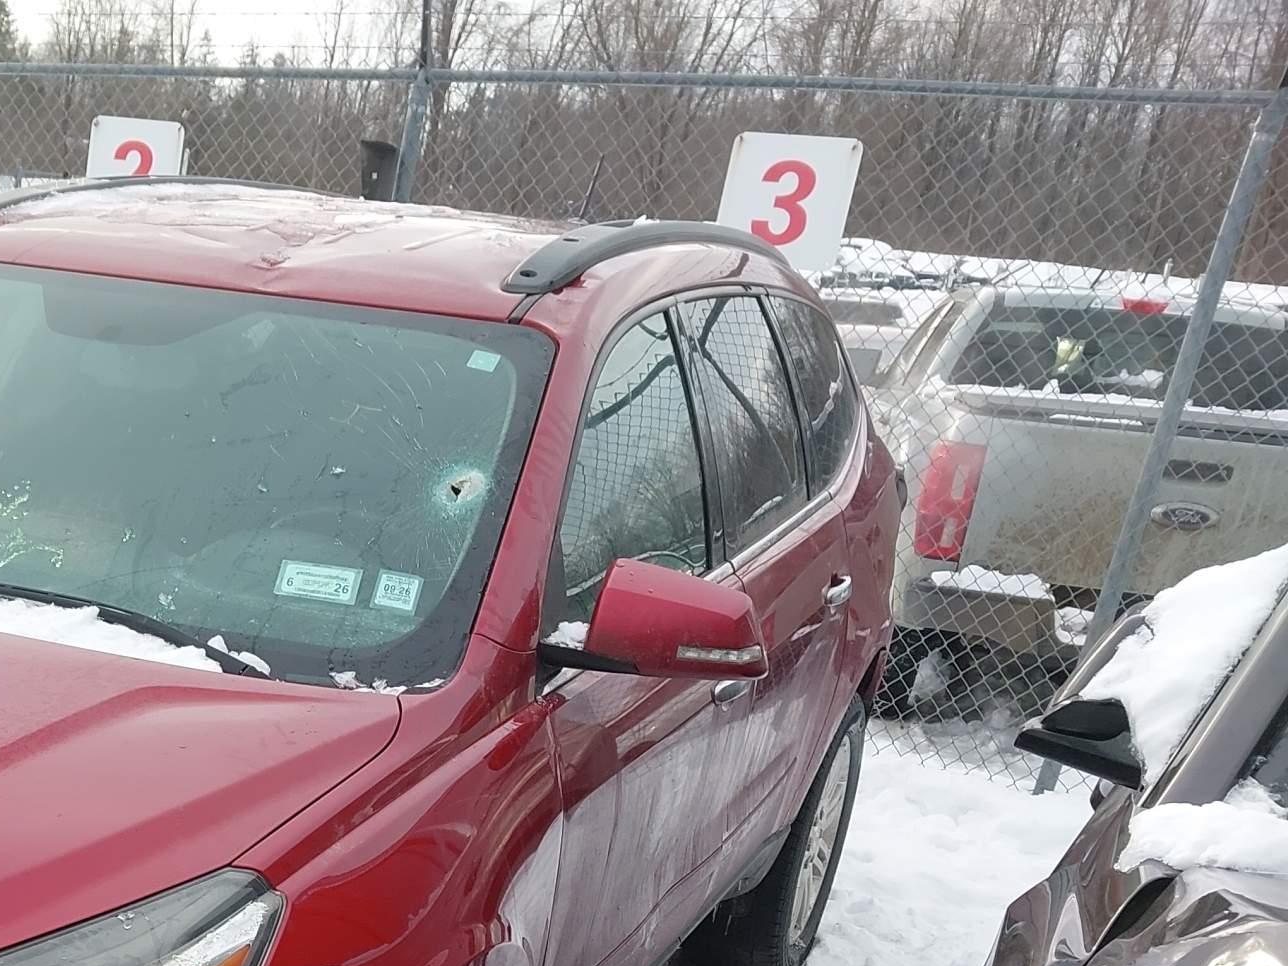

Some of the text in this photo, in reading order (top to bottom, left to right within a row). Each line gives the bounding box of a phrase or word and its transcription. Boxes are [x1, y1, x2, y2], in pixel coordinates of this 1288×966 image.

[114, 140, 154, 176] 2
[751, 160, 816, 245] 3
[286, 577, 295, 588] 6
[333, 583, 350, 595] 26
